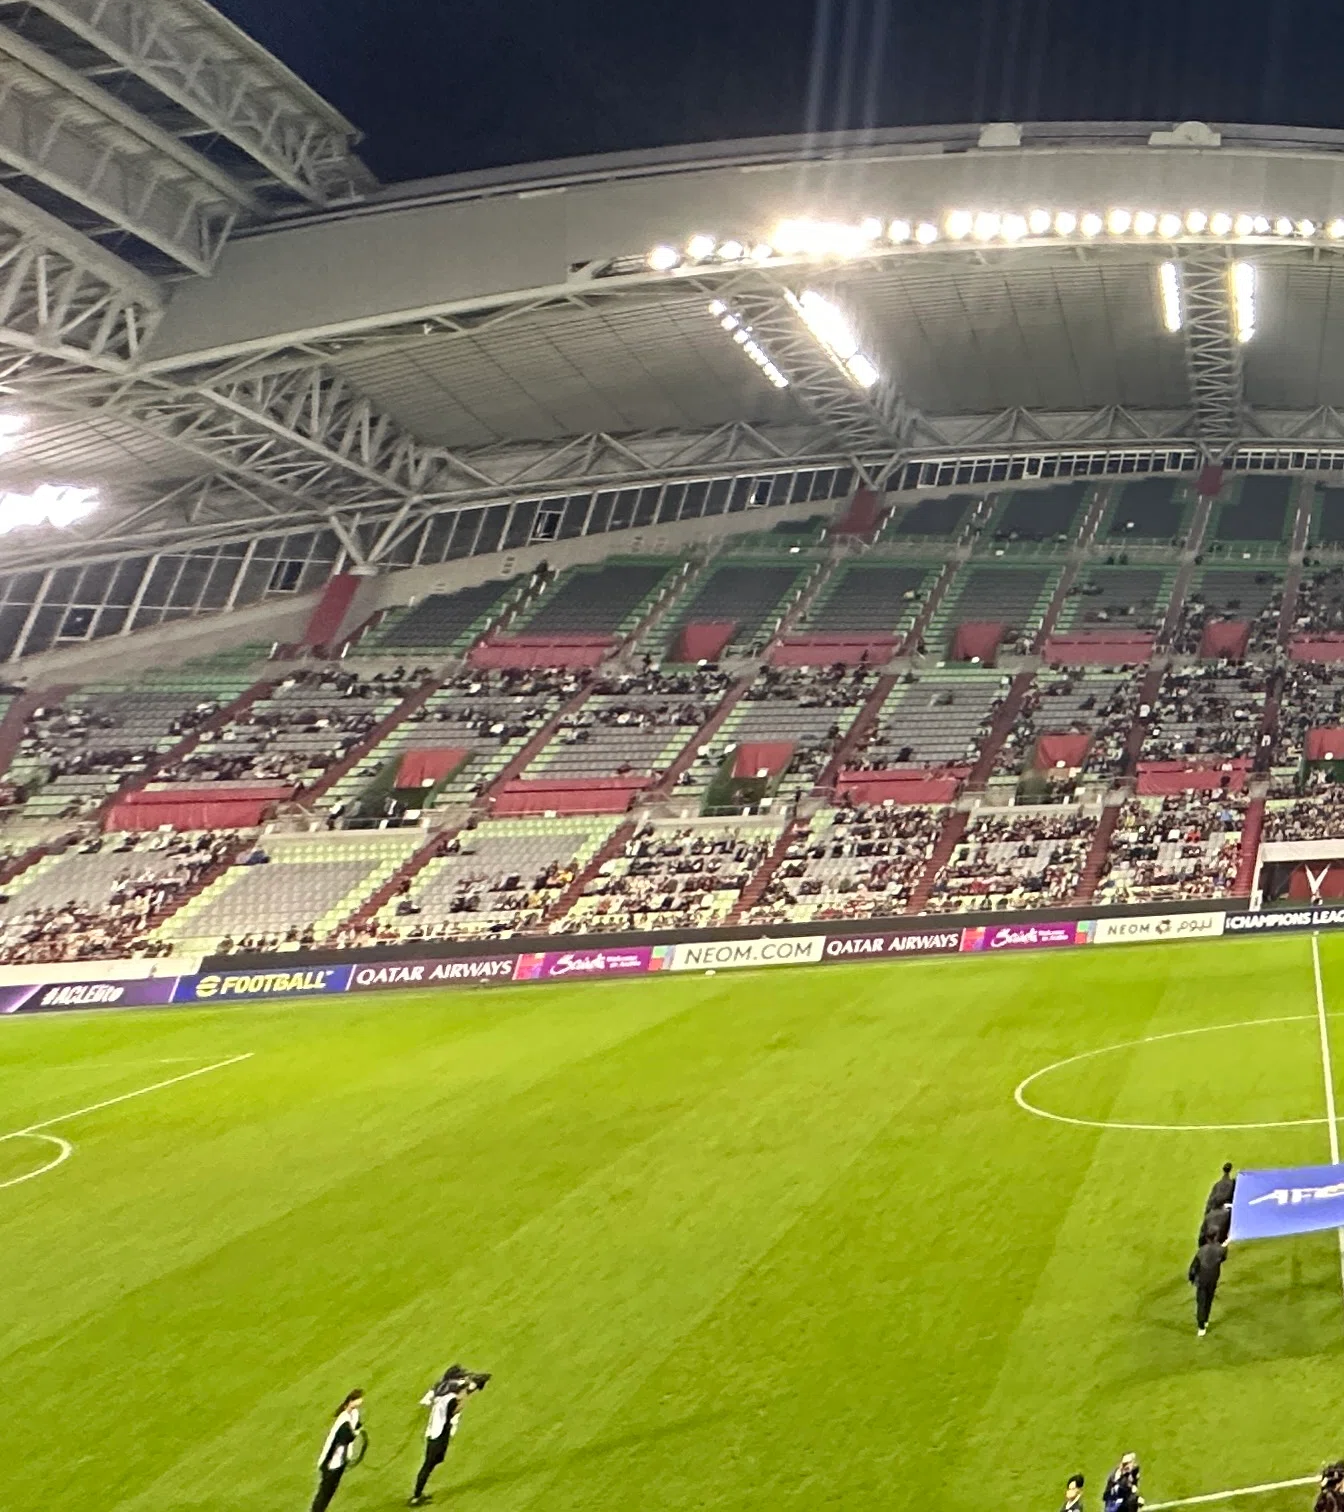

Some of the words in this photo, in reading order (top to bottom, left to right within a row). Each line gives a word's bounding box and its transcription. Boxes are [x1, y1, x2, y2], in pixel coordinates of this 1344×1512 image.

[1107, 922, 1150, 935] NEOM
[1230, 913, 1312, 930] CHAMPIONS
[684, 941, 813, 965] NEOM.COM
[826, 938, 884, 956] QATAR
[888, 933, 958, 952] AIRWAYS
[356, 965, 425, 986] QATAR
[429, 959, 514, 981] AIRWAYS
